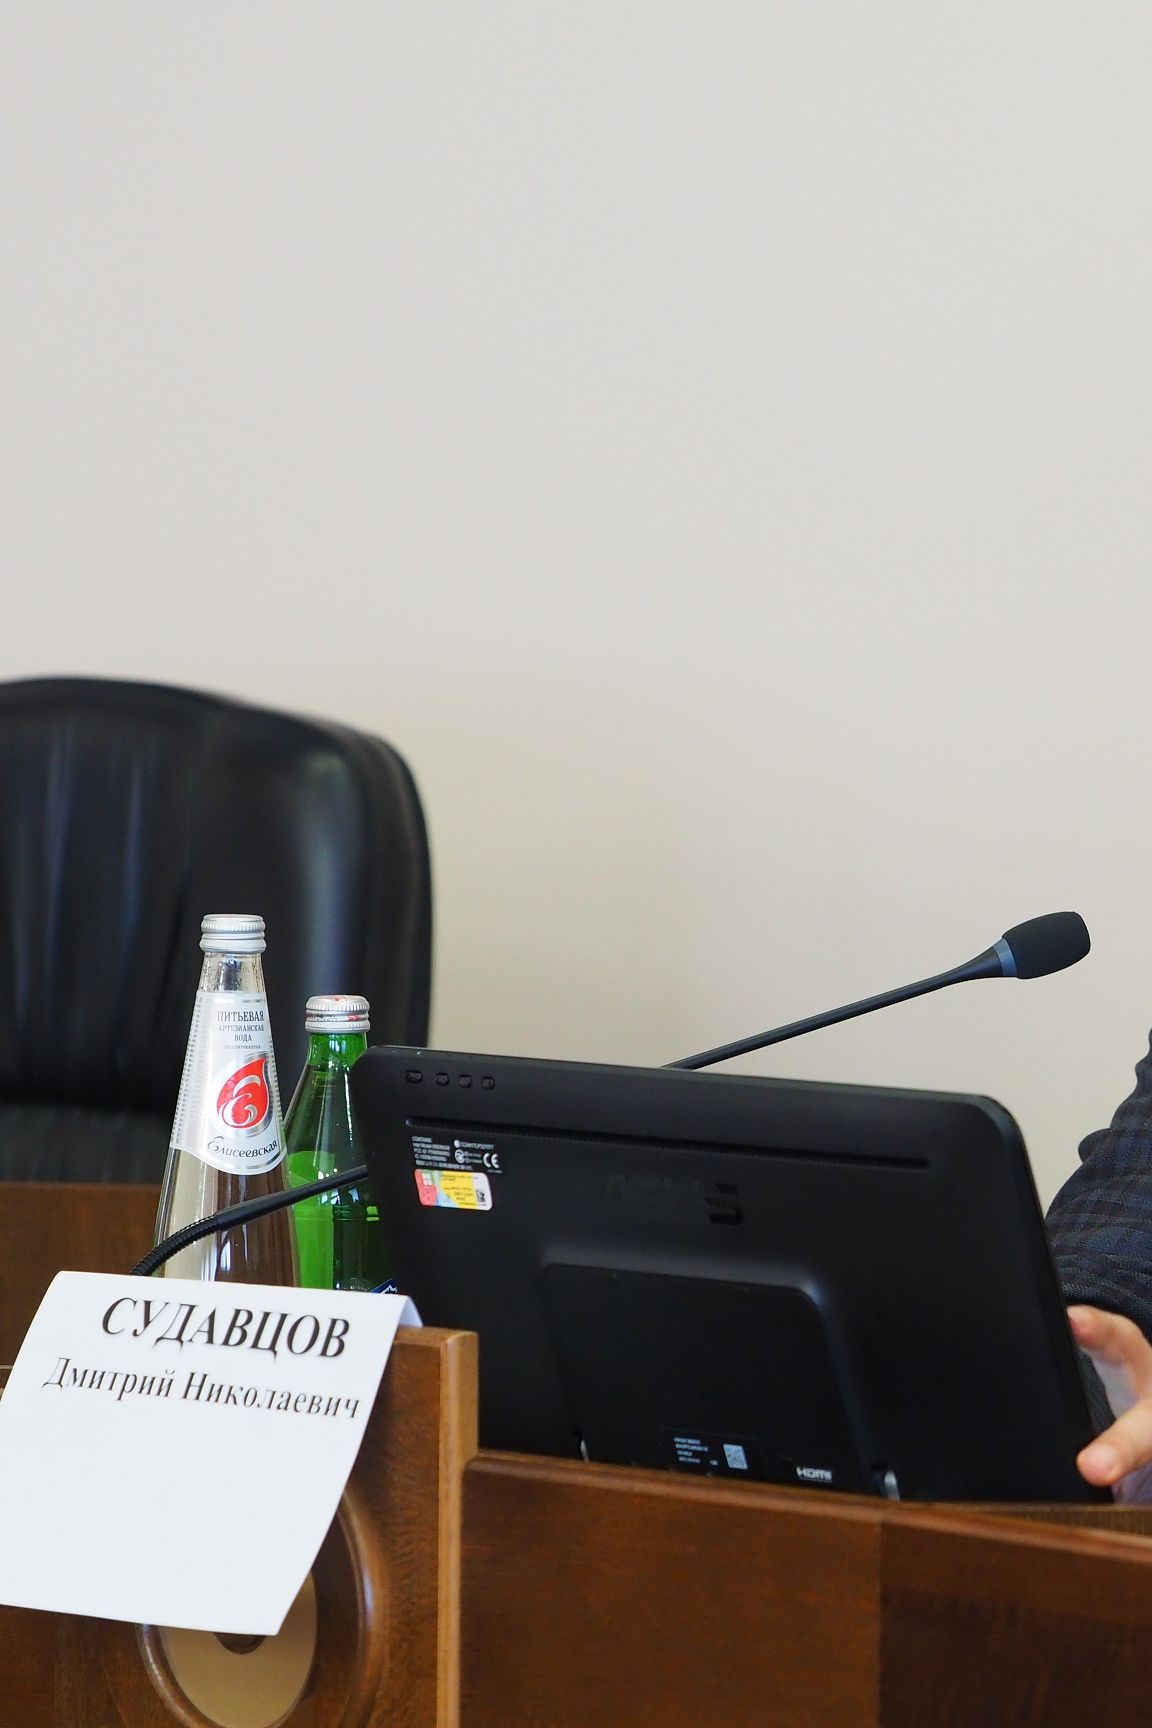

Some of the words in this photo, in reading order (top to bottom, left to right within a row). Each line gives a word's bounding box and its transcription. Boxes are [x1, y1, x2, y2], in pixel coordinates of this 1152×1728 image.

[217, 1010, 265, 1022] ПИТЬЕВАЯ
[234, 1034, 253, 1043] ВОДА
[207, 1136, 278, 1158] Елисеевская
[102, 1297, 351, 1361] СУДАВЦОВ
[42, 1357, 175, 1402] Дмитрий
[181, 1372, 361, 1419] Николаевич
